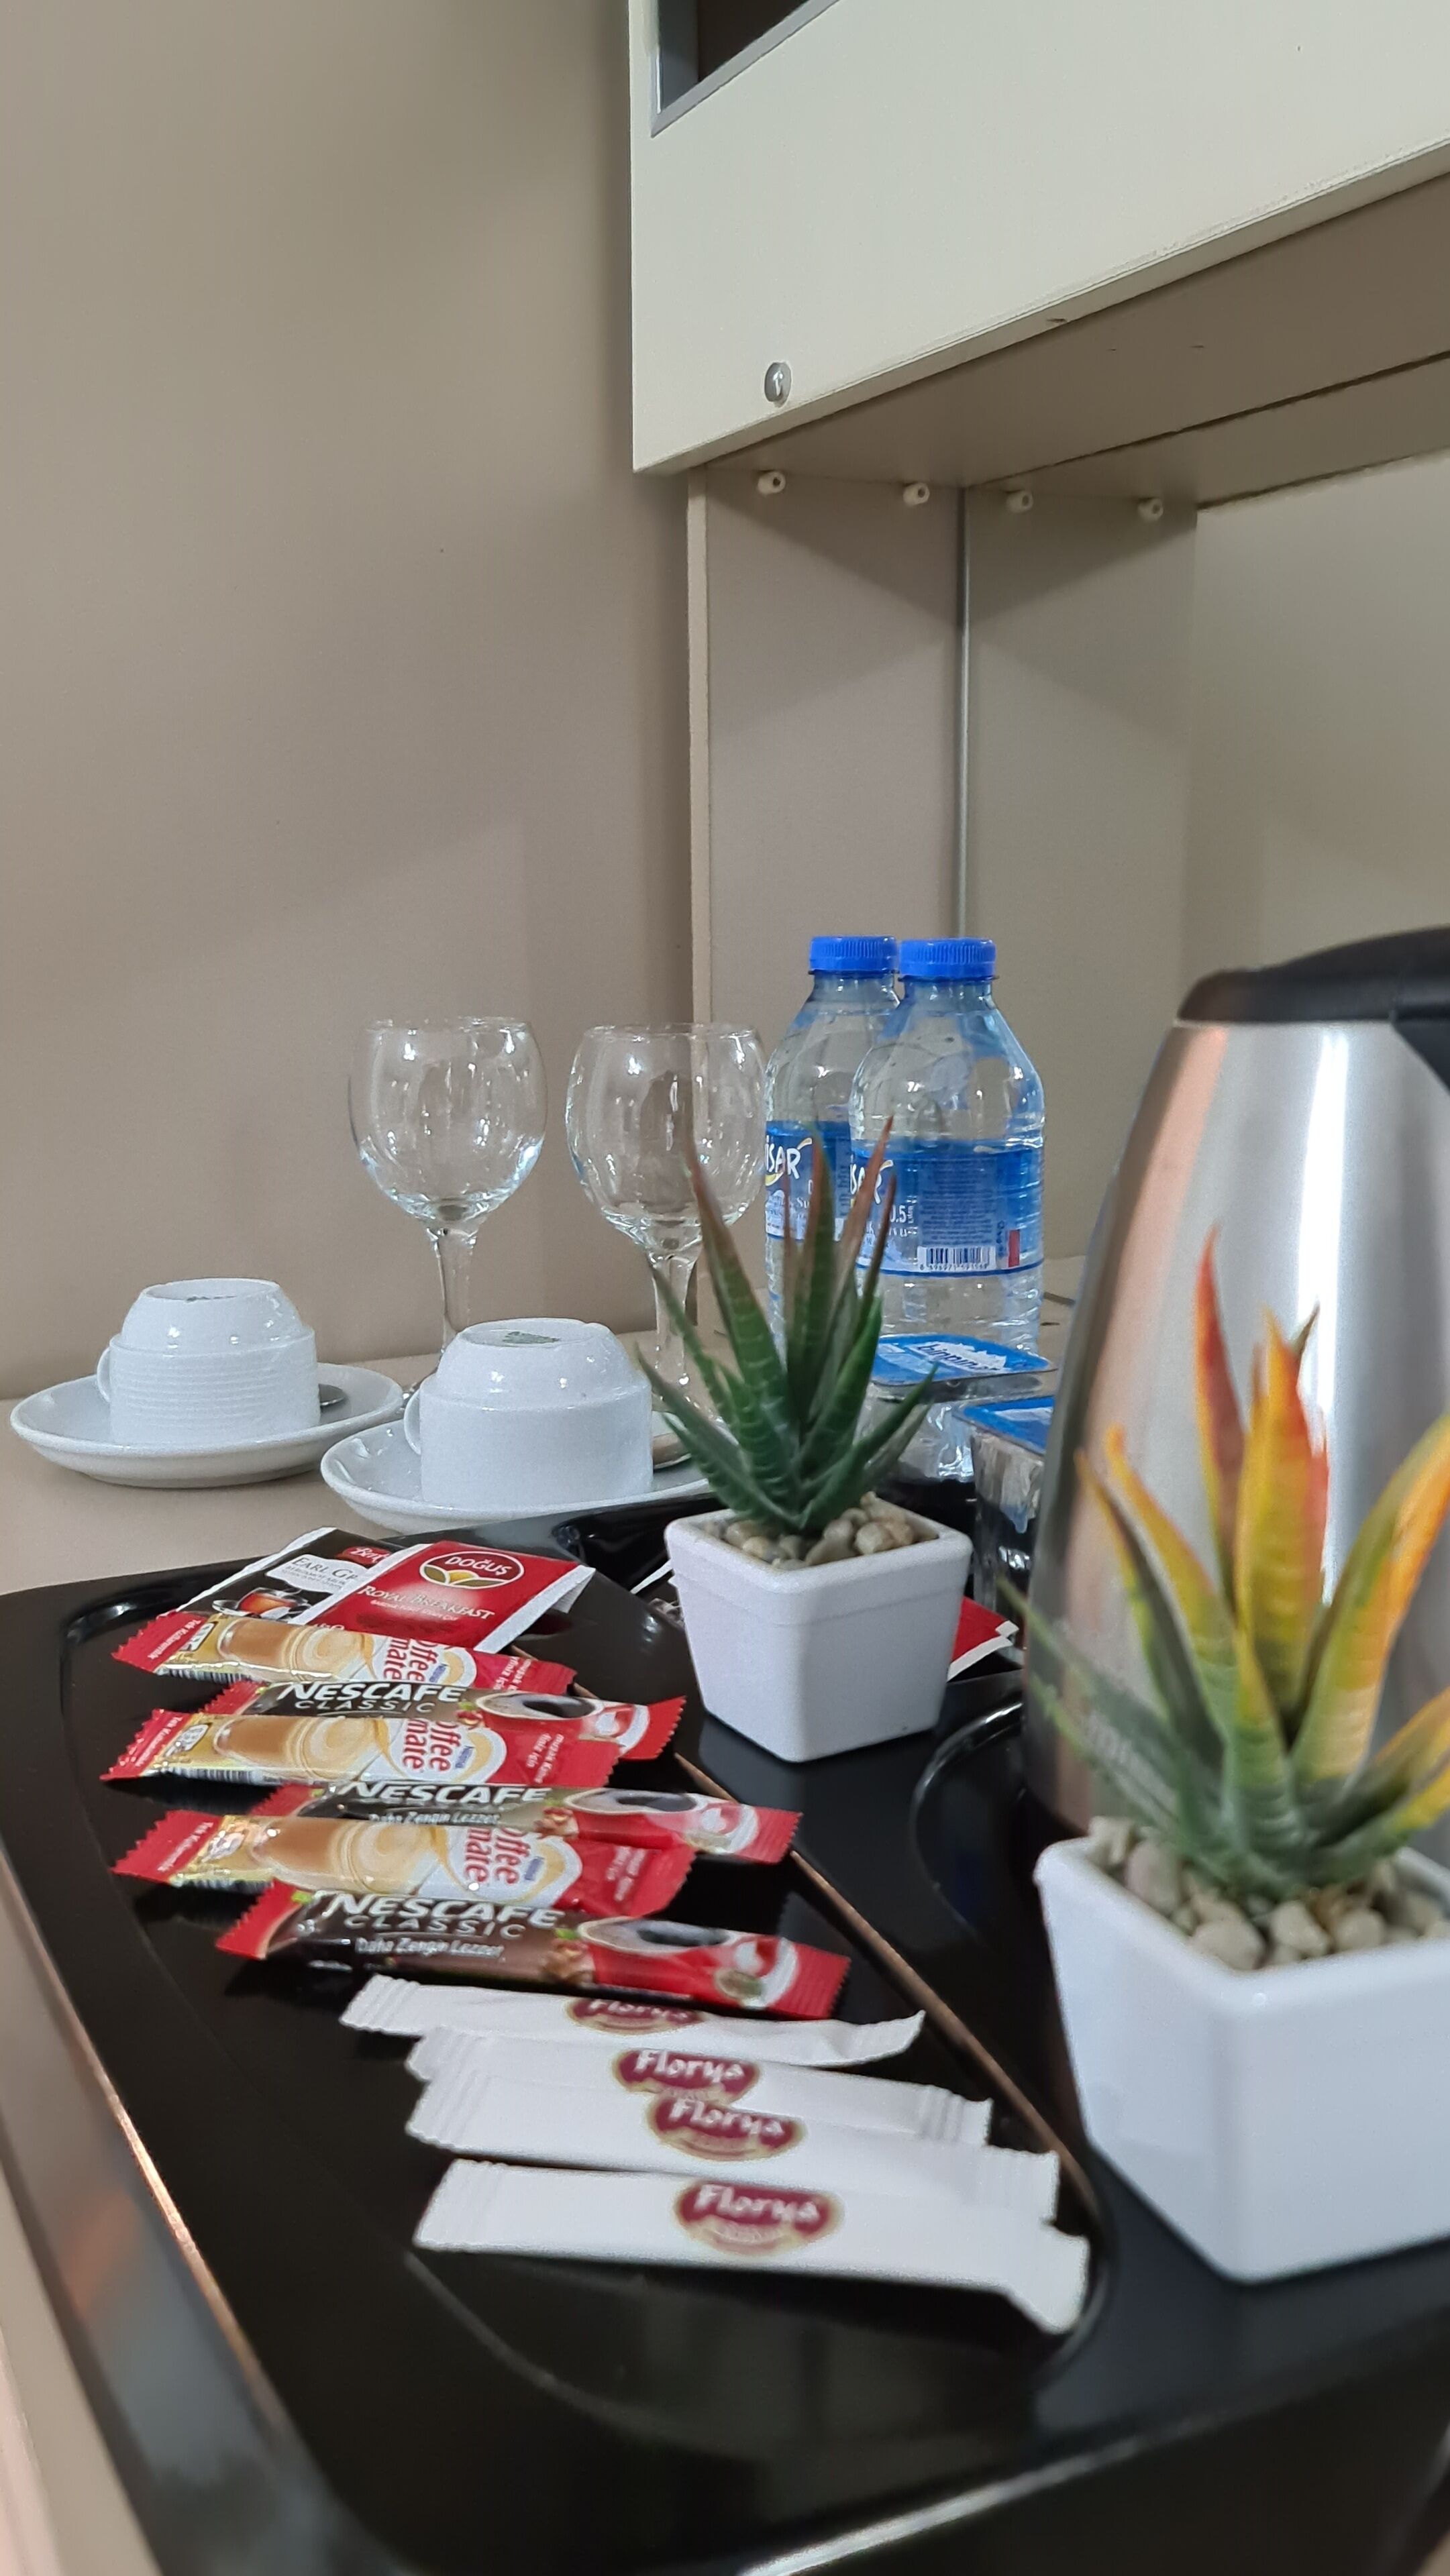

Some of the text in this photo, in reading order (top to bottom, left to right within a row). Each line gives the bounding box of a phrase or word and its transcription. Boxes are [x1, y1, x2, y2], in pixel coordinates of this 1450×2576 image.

[291, 1557, 329, 1572] EARL
[444, 1556, 513, 1576] DOĞUŞ
[357, 1585, 407, 1603] ROYAL
[410, 1593, 495, 1620] BREAKFAST
[185, 1619, 201, 1629] Tek
[295, 1699, 435, 1713] CLASSIC
[402, 1718, 428, 1770] mate
[344, 1914, 526, 1940] CLASSIC
[633, 2049, 745, 2084] Florya
[668, 2097, 785, 2137] Florya
[692, 2183, 821, 2223] Florya
